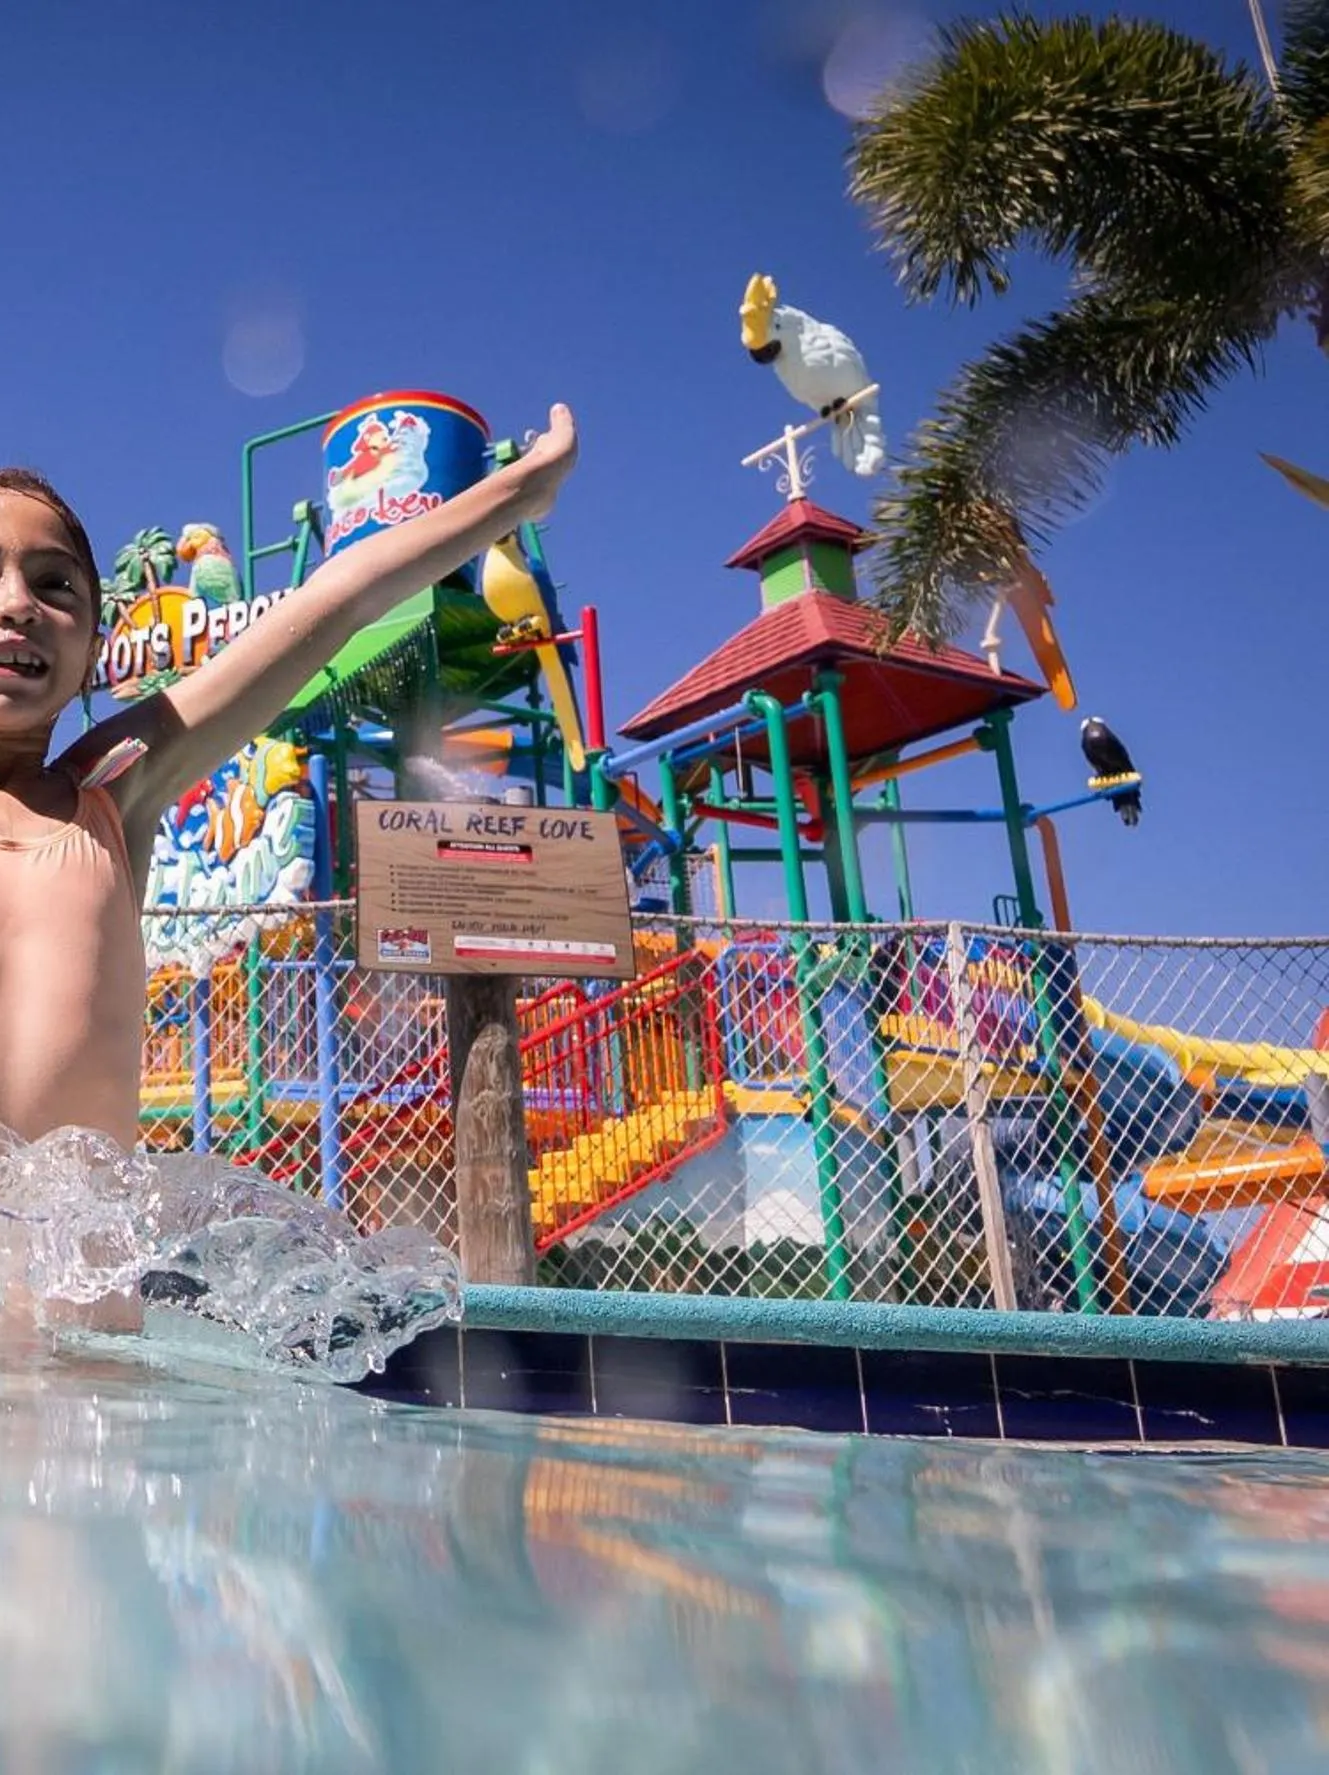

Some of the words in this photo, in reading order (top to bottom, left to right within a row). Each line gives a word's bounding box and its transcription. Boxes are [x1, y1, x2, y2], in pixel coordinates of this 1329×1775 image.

[92, 624, 170, 685] ROTS
[378, 808, 453, 835] CORAL
[465, 814, 526, 836] REEF
[540, 818, 595, 841] COVE
